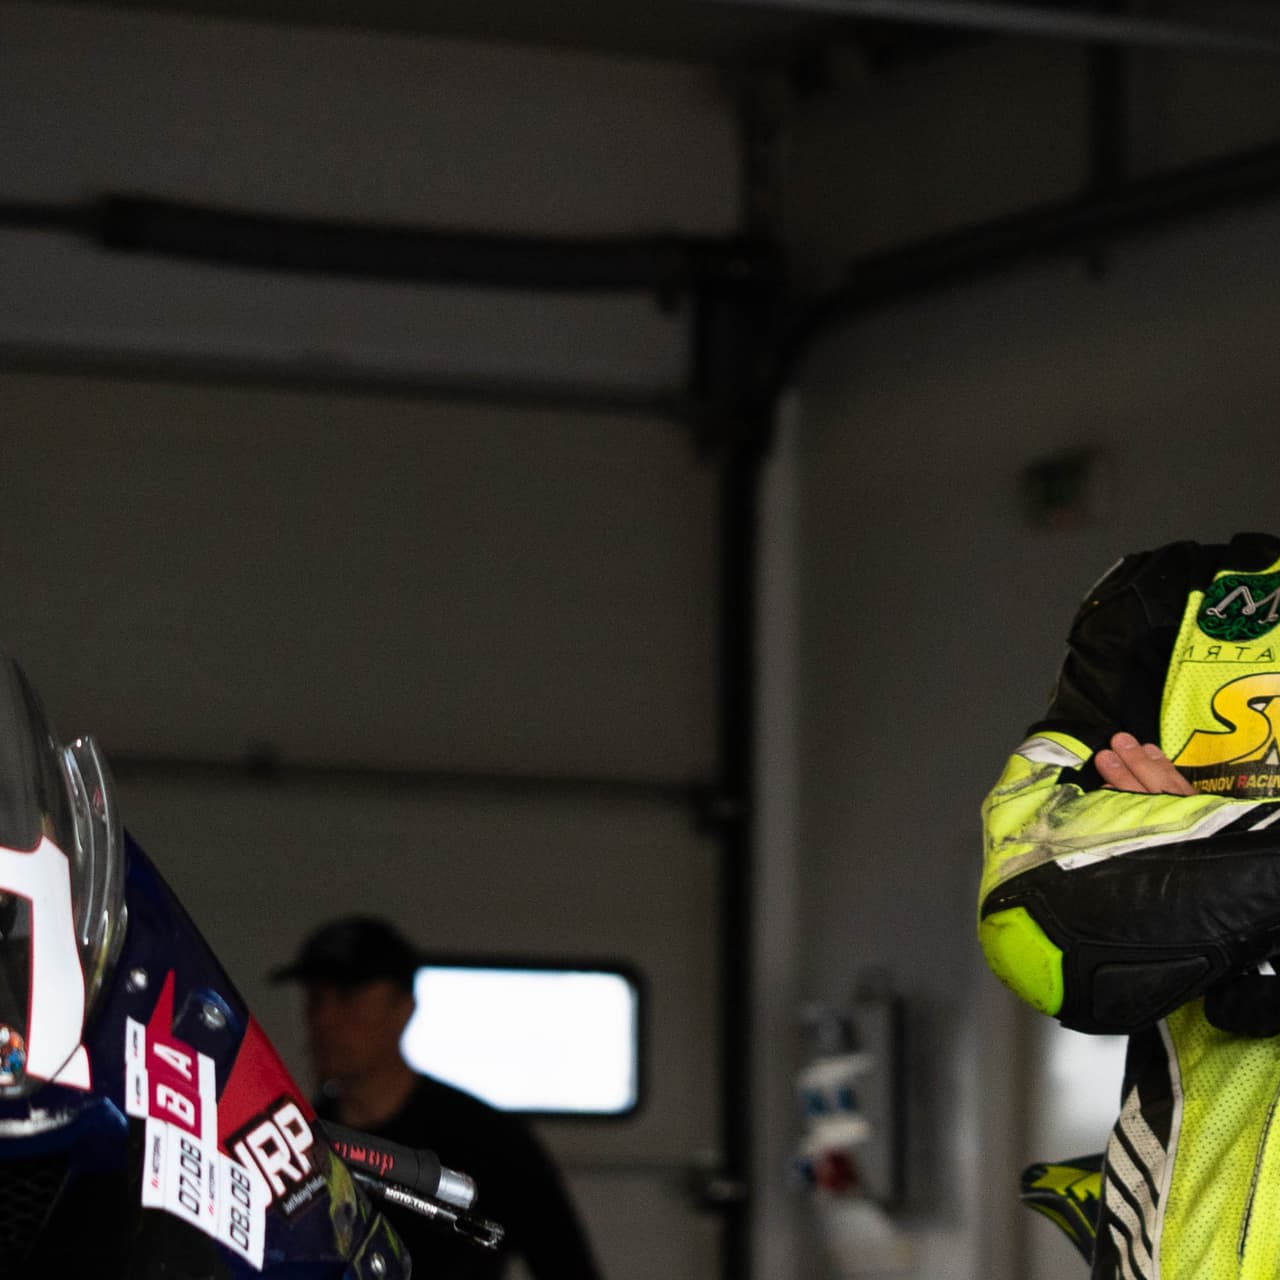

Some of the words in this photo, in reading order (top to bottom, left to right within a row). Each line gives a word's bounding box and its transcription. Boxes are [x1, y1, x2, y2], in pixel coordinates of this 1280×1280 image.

[156, 1083, 195, 1128] B
[178, 1138, 202, 1216] 07.08
[230, 1102, 314, 1207] JRP
[229, 1167, 251, 1251] 08.08
